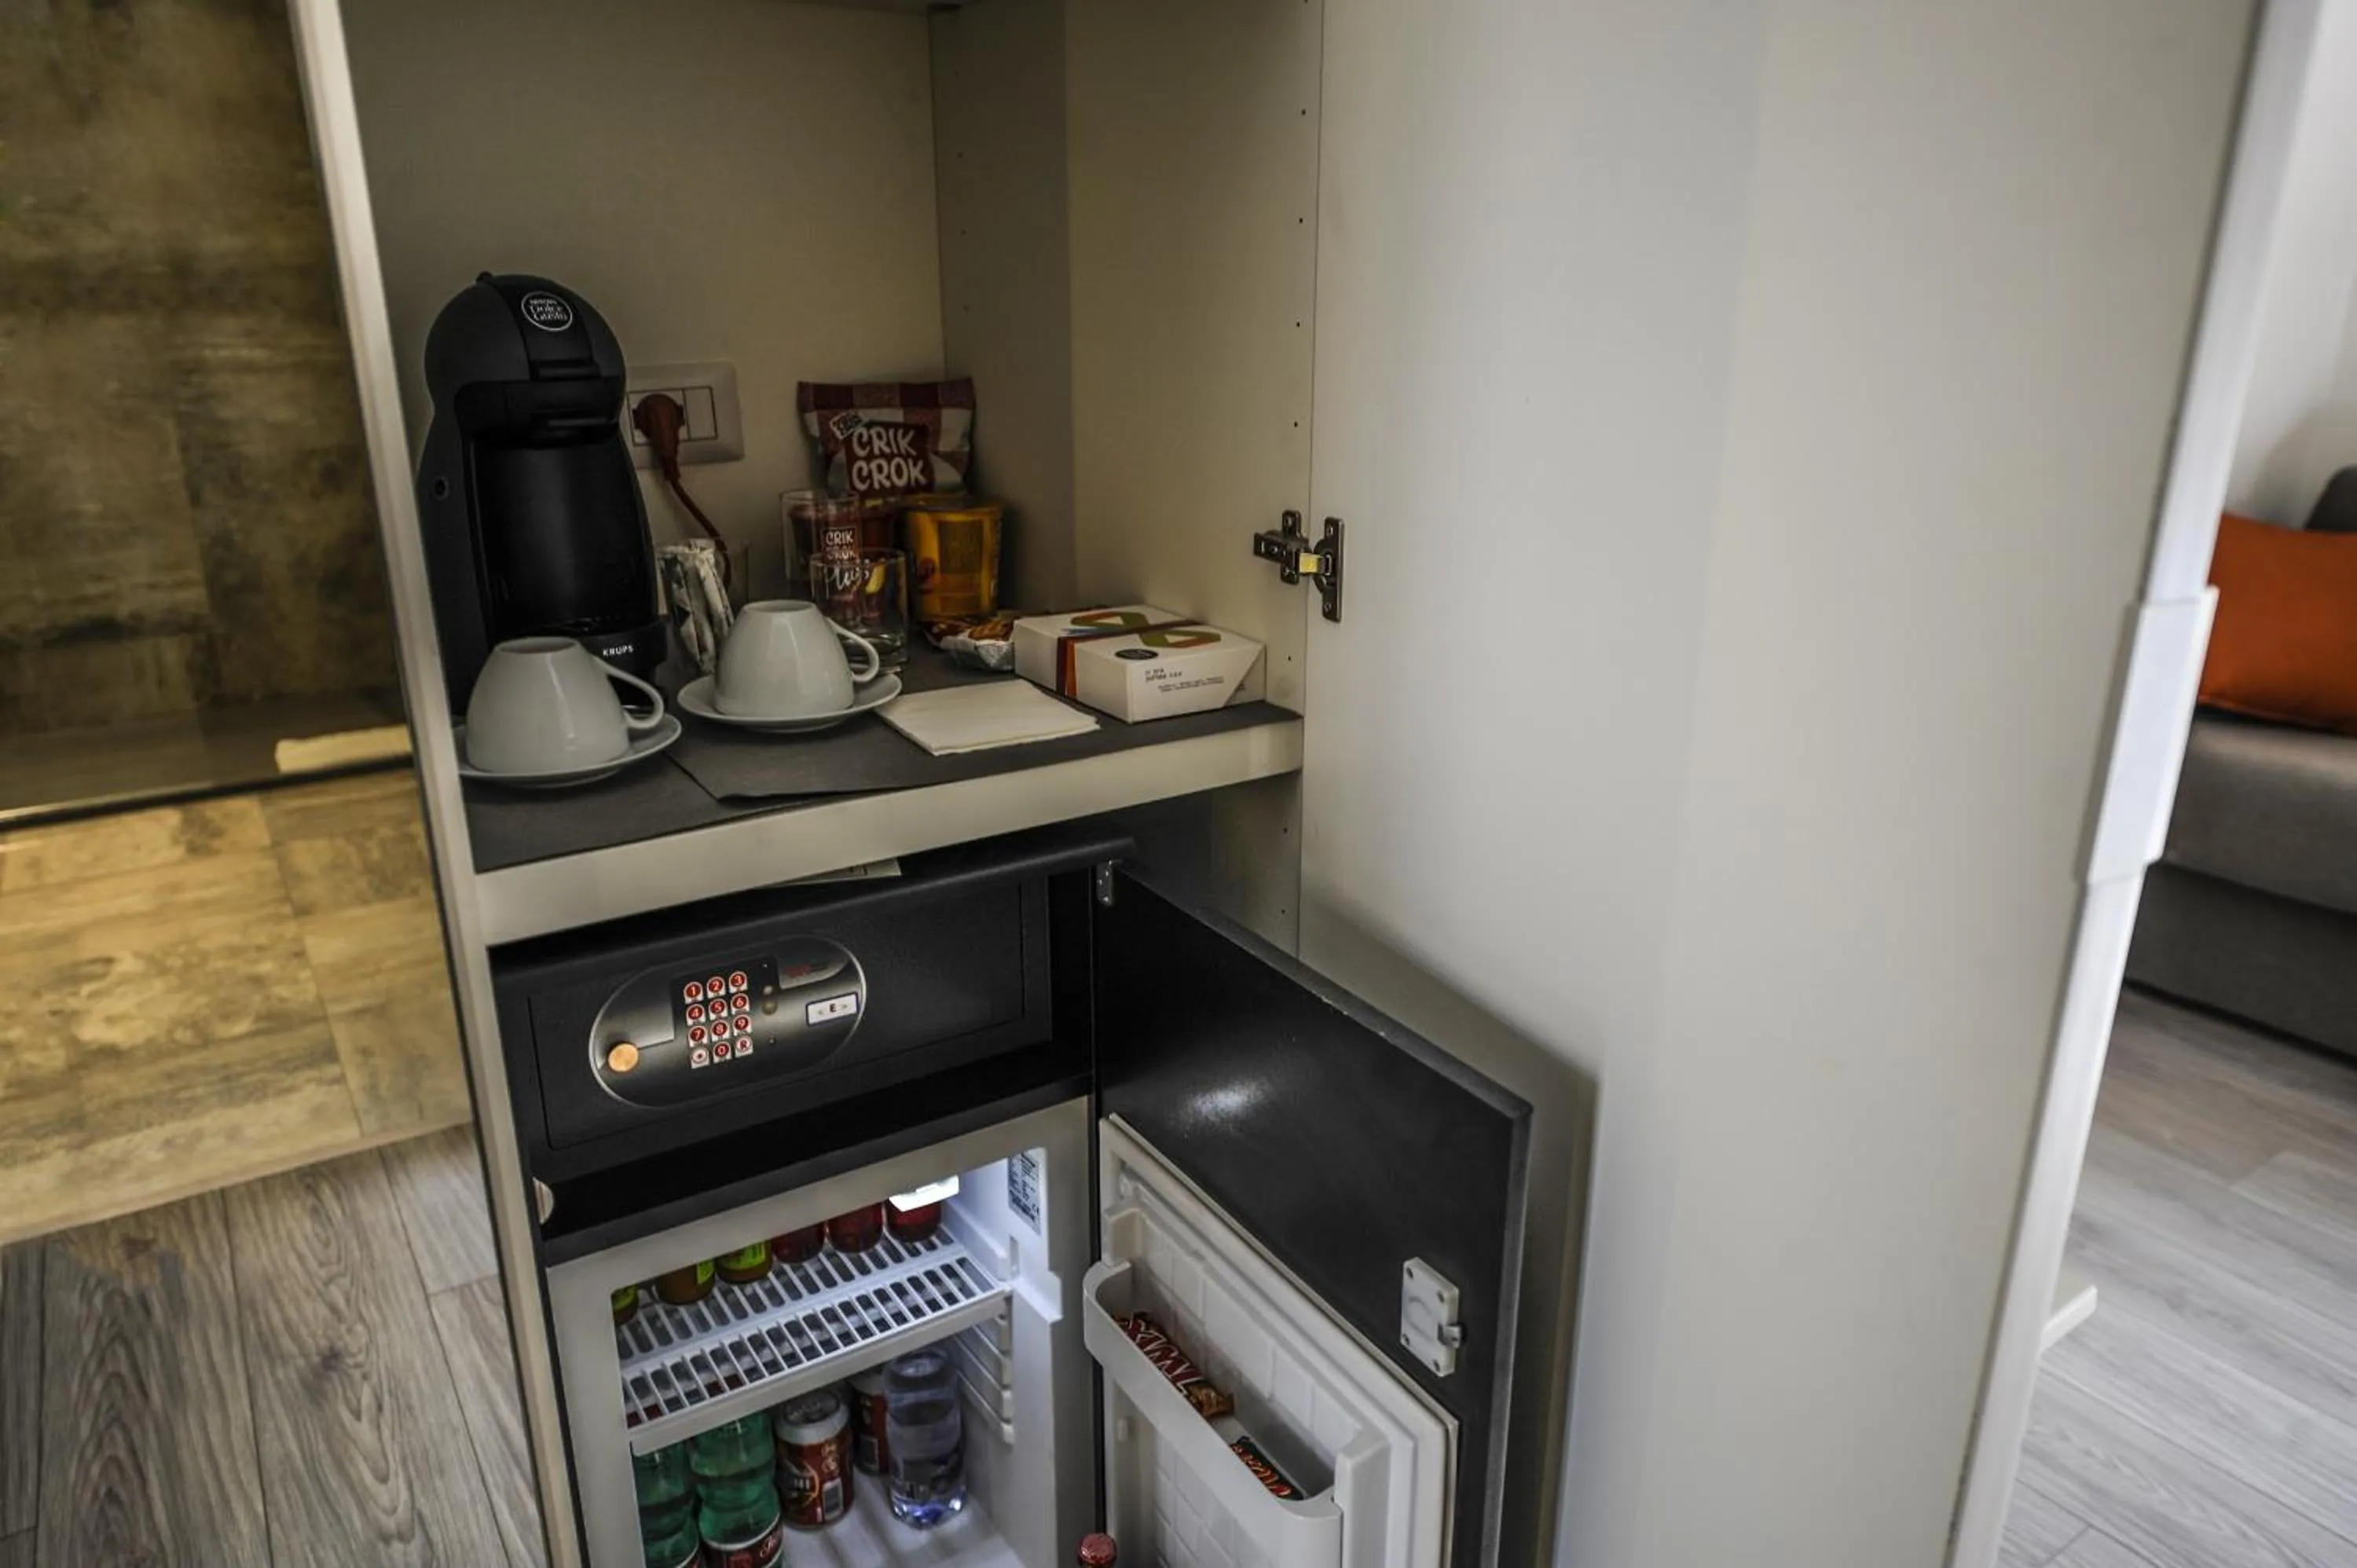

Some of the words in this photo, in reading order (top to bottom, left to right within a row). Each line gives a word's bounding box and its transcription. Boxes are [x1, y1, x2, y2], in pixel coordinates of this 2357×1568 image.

[852, 425, 918, 458] CRIK
[851, 456, 928, 492] CROK
[825, 529, 854, 545] CRIK
[602, 644, 634, 657] KRUPS
[830, 1003, 837, 1012] E
